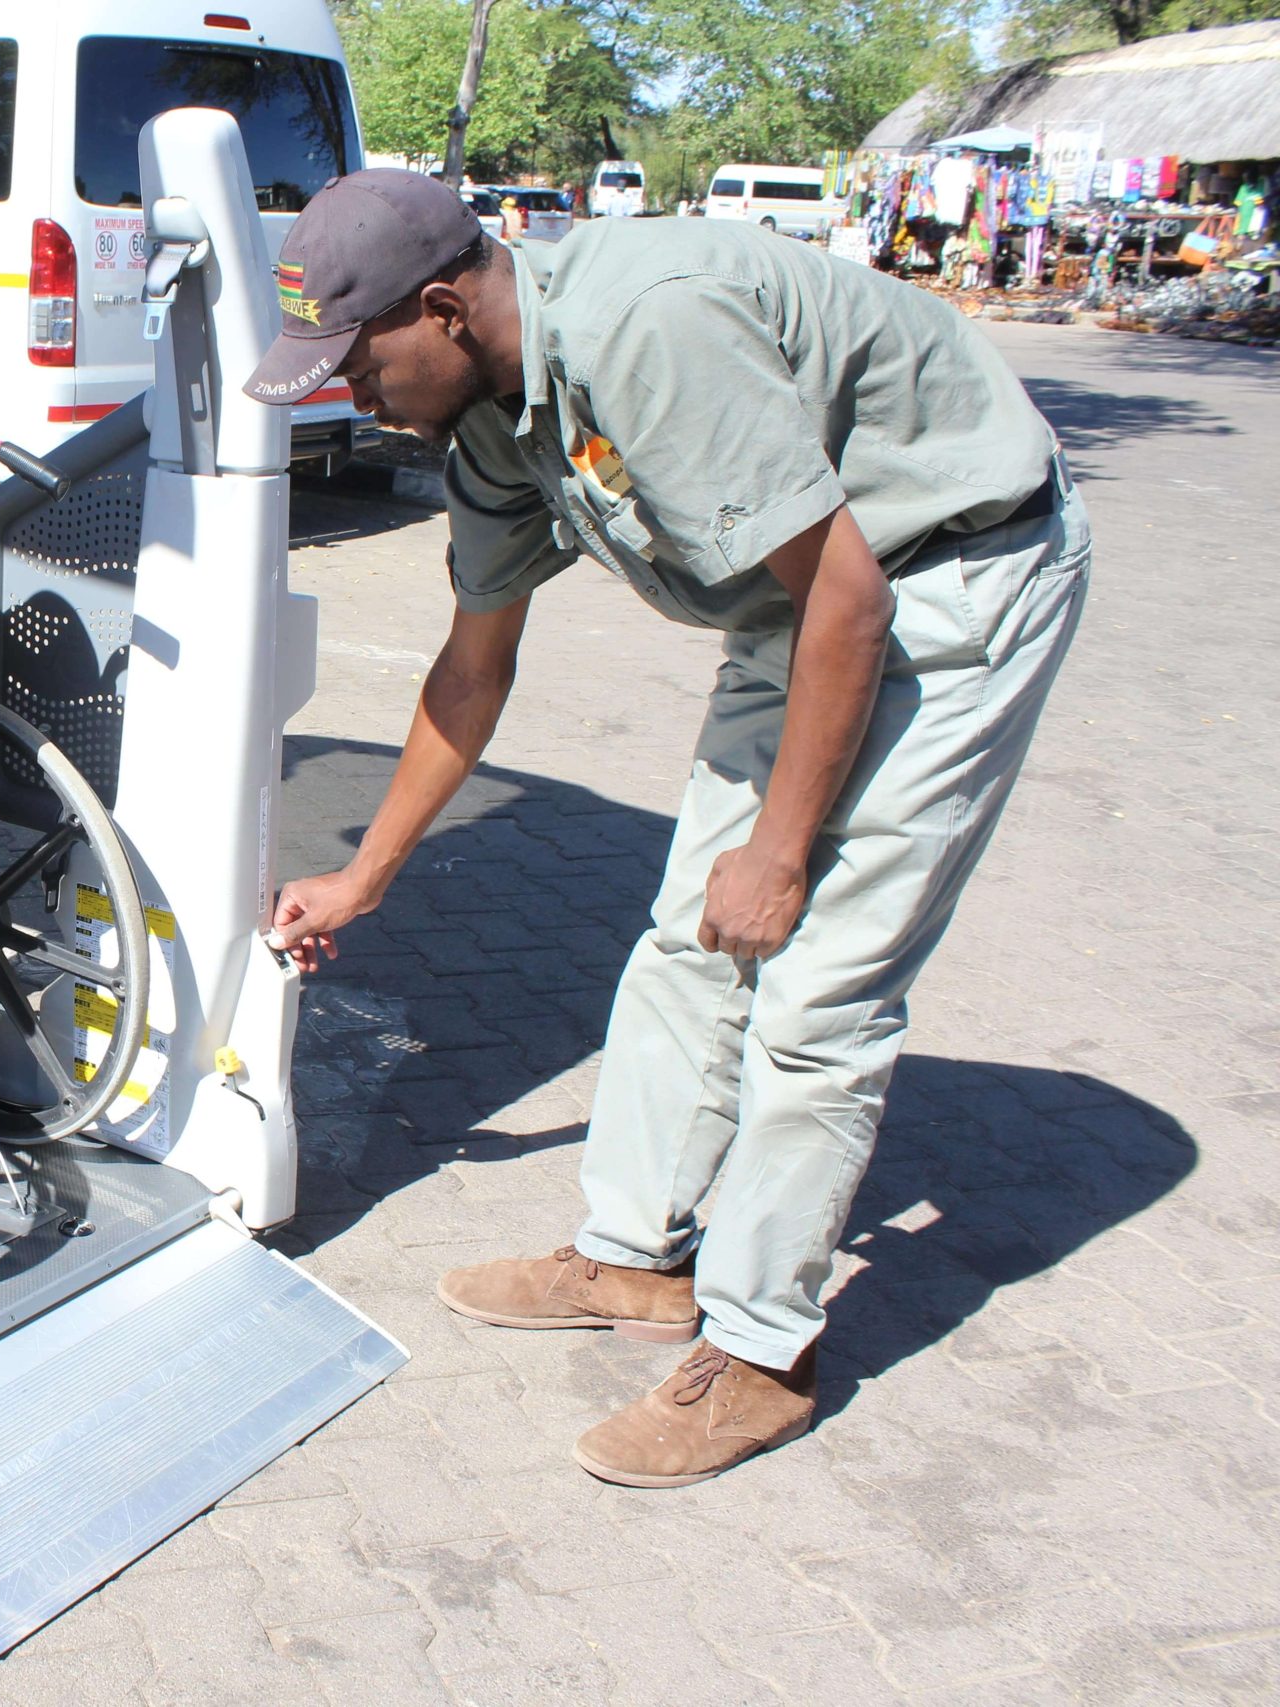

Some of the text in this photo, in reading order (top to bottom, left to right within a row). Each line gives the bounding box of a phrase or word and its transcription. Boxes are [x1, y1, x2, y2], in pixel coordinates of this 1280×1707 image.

[95, 218, 144, 229] MAXIMUM SPEE
[99, 235, 113, 252] 80
[254, 357, 331, 396] ZIMBABWE
